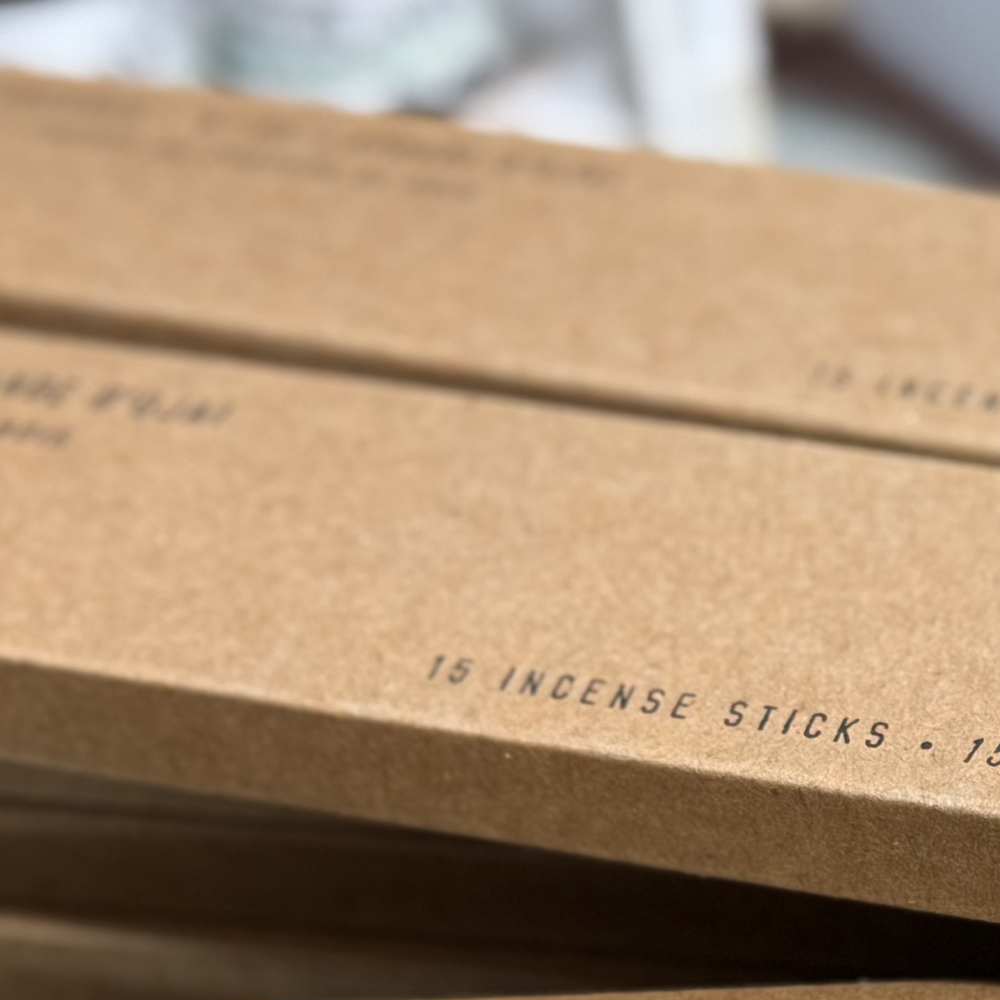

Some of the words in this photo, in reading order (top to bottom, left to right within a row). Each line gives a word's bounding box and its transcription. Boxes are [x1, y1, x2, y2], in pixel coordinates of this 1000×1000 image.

[428, 655, 472, 685] 15
[498, 666, 697, 720] INCENSE
[723, 699, 890, 749] STICKS
